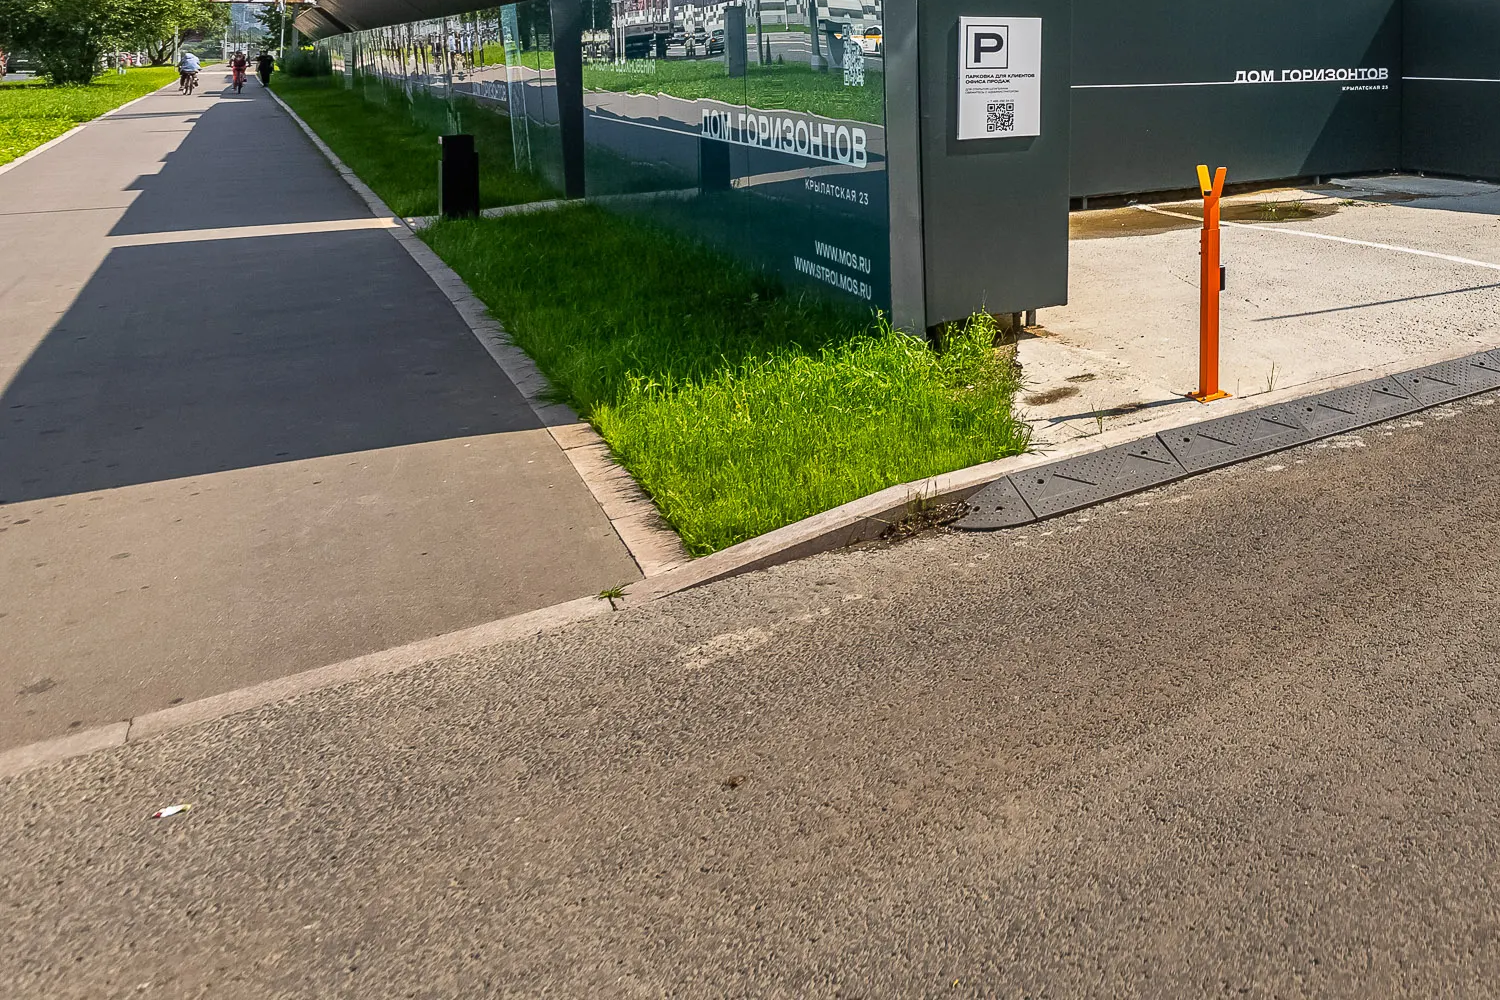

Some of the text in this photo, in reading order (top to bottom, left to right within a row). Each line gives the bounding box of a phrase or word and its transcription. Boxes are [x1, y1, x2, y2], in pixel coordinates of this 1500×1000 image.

[974, 32, 1004, 63] P
[1234, 67, 1389, 82] ДОМ ГОРИЗОНТОВ
[701, 108, 868, 168] ДОМ ГОРИЗОНТОВ
[804, 178, 869, 206] КРЫЛАТСКАЯ 23
[814, 240, 871, 274] WWW.MOS.RU
[793, 255, 872, 300] WWW.STROI.MOS.RU
